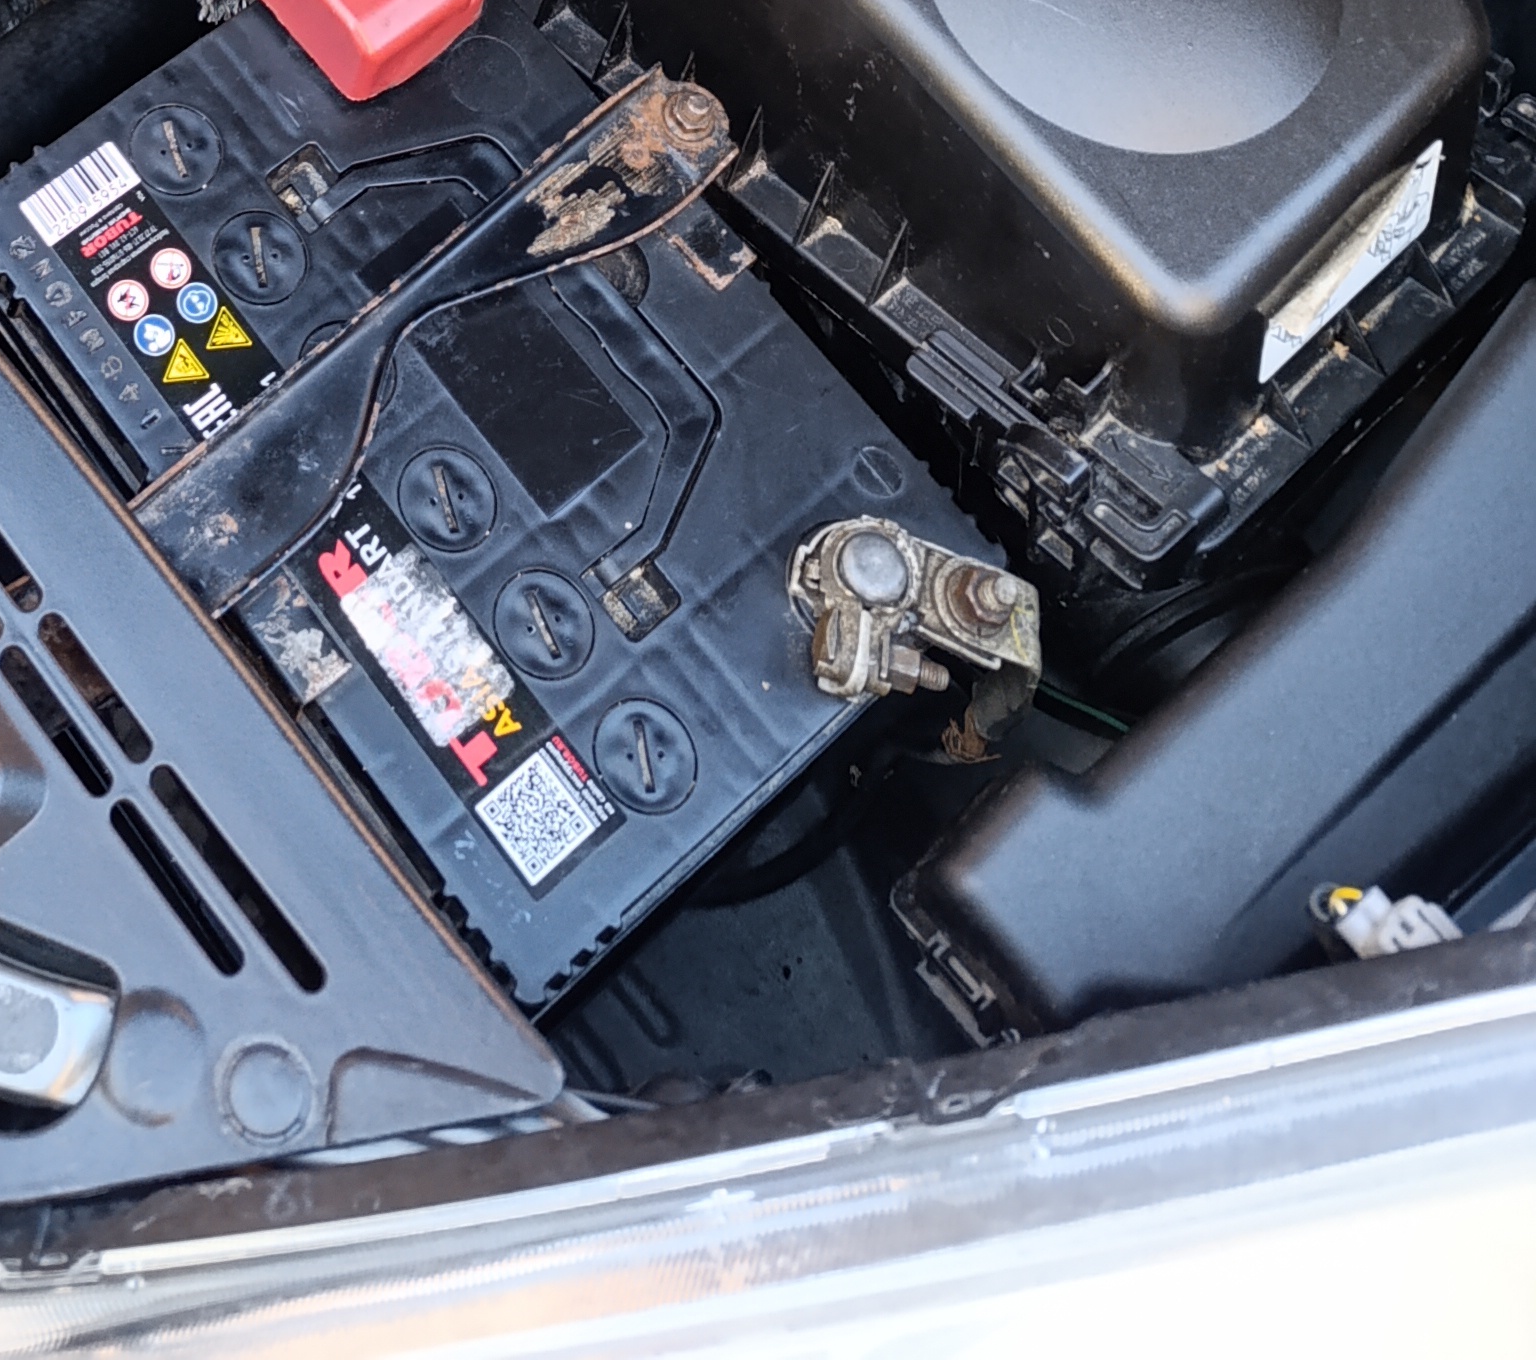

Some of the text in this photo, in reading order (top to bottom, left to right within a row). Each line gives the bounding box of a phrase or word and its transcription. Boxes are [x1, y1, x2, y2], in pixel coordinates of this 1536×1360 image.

[52, 179, 126, 236] 2209 5954
[78, 209, 143, 259] TUBOR
